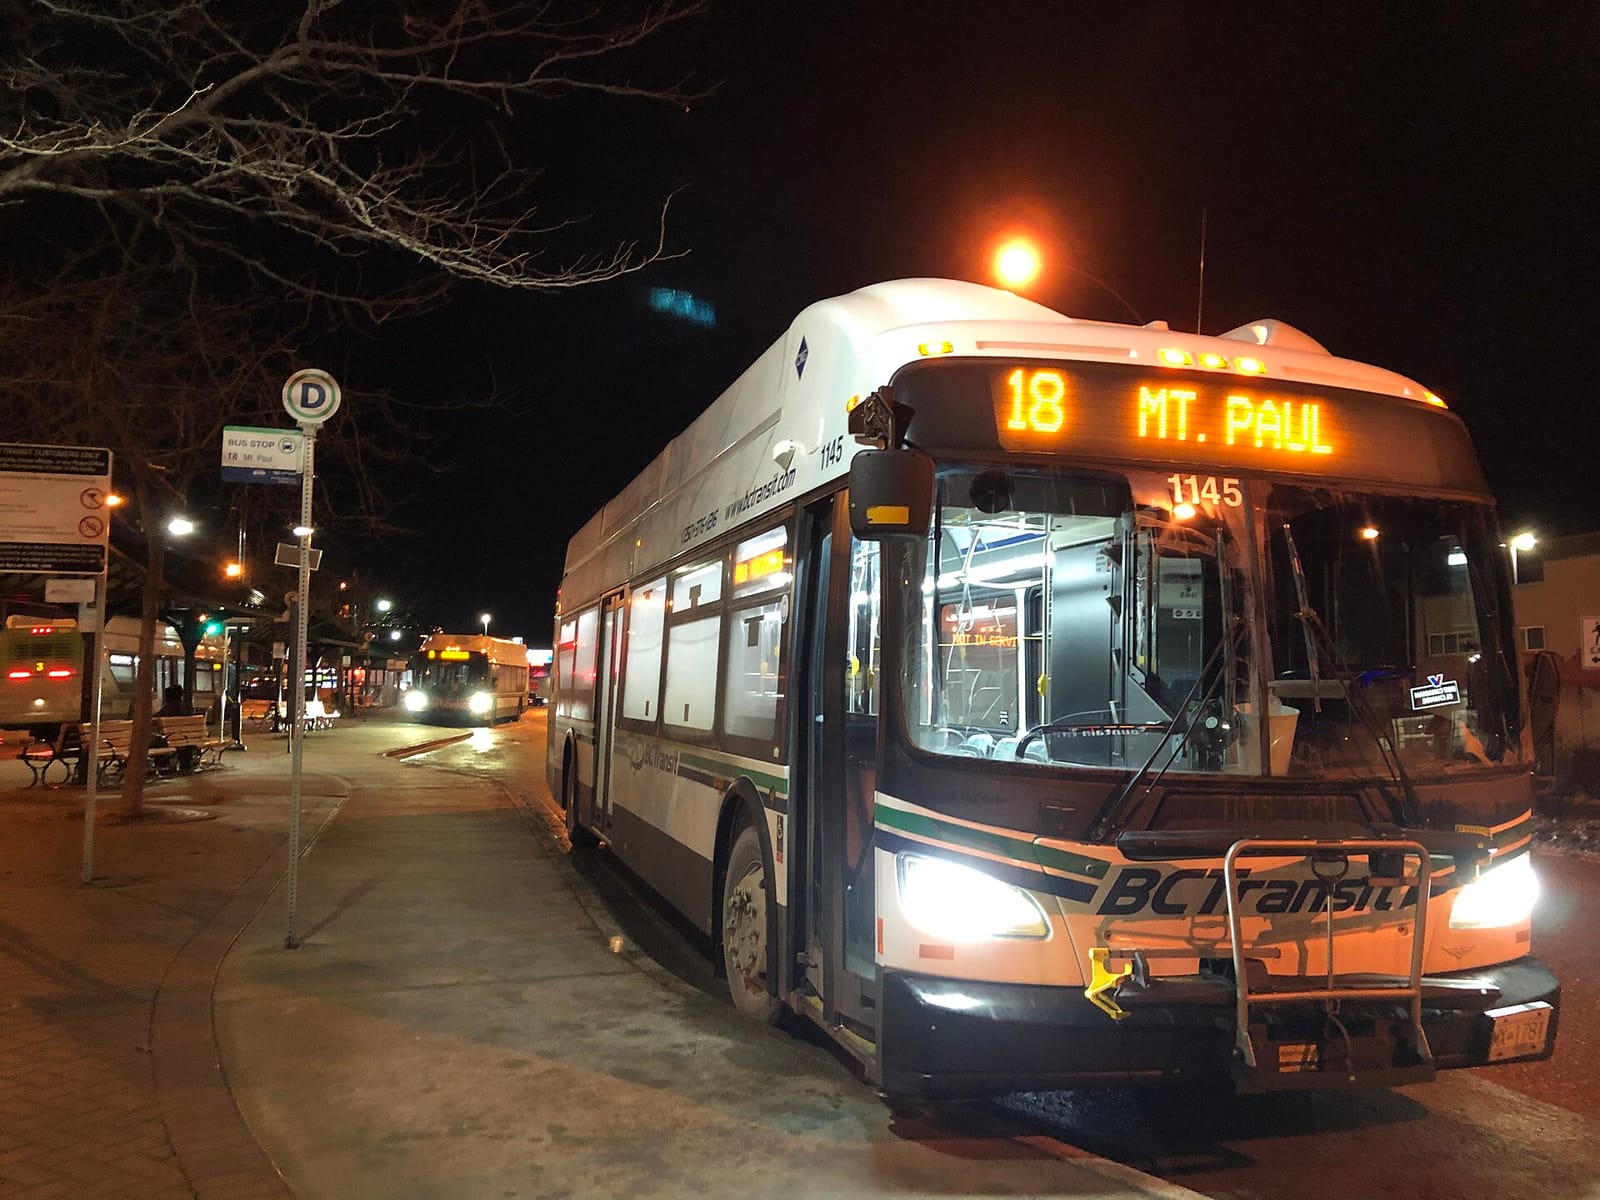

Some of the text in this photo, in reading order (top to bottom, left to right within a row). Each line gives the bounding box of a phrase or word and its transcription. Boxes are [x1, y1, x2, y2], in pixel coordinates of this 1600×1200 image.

[301, 382, 326, 409] D
[1007, 369, 1333, 454] 18 MT. PAUL
[228, 439, 275, 448] BUS STOP
[228, 452, 238, 460] 18
[820, 435, 844, 471] 1145
[724, 468, 797, 521] www.bctransit.com
[1167, 473, 1243, 508] 1145
[952, 633, 971, 645] NOT
[36, 662, 44, 671] 3
